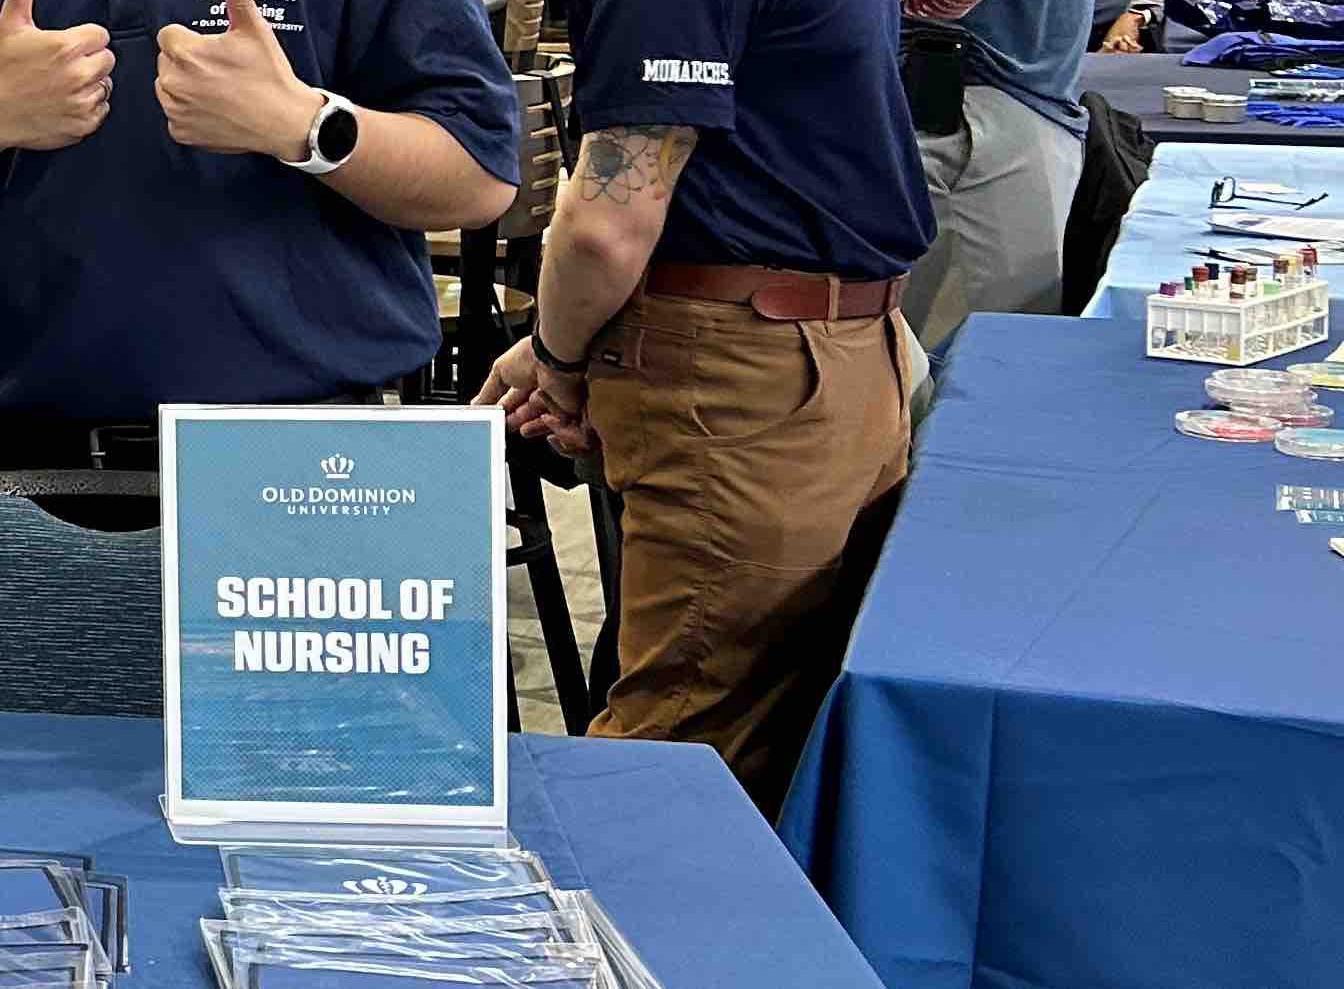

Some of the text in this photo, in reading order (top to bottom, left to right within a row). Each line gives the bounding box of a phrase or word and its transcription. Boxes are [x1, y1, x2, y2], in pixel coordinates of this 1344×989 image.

[210, 2, 227, 15] of
[262, 487, 416, 504] OLD DOMINION
[287, 505, 391, 516] UNIVERSITY
[217, 576, 455, 620] SCHOOL OF
[233, 631, 431, 674] NURSING
